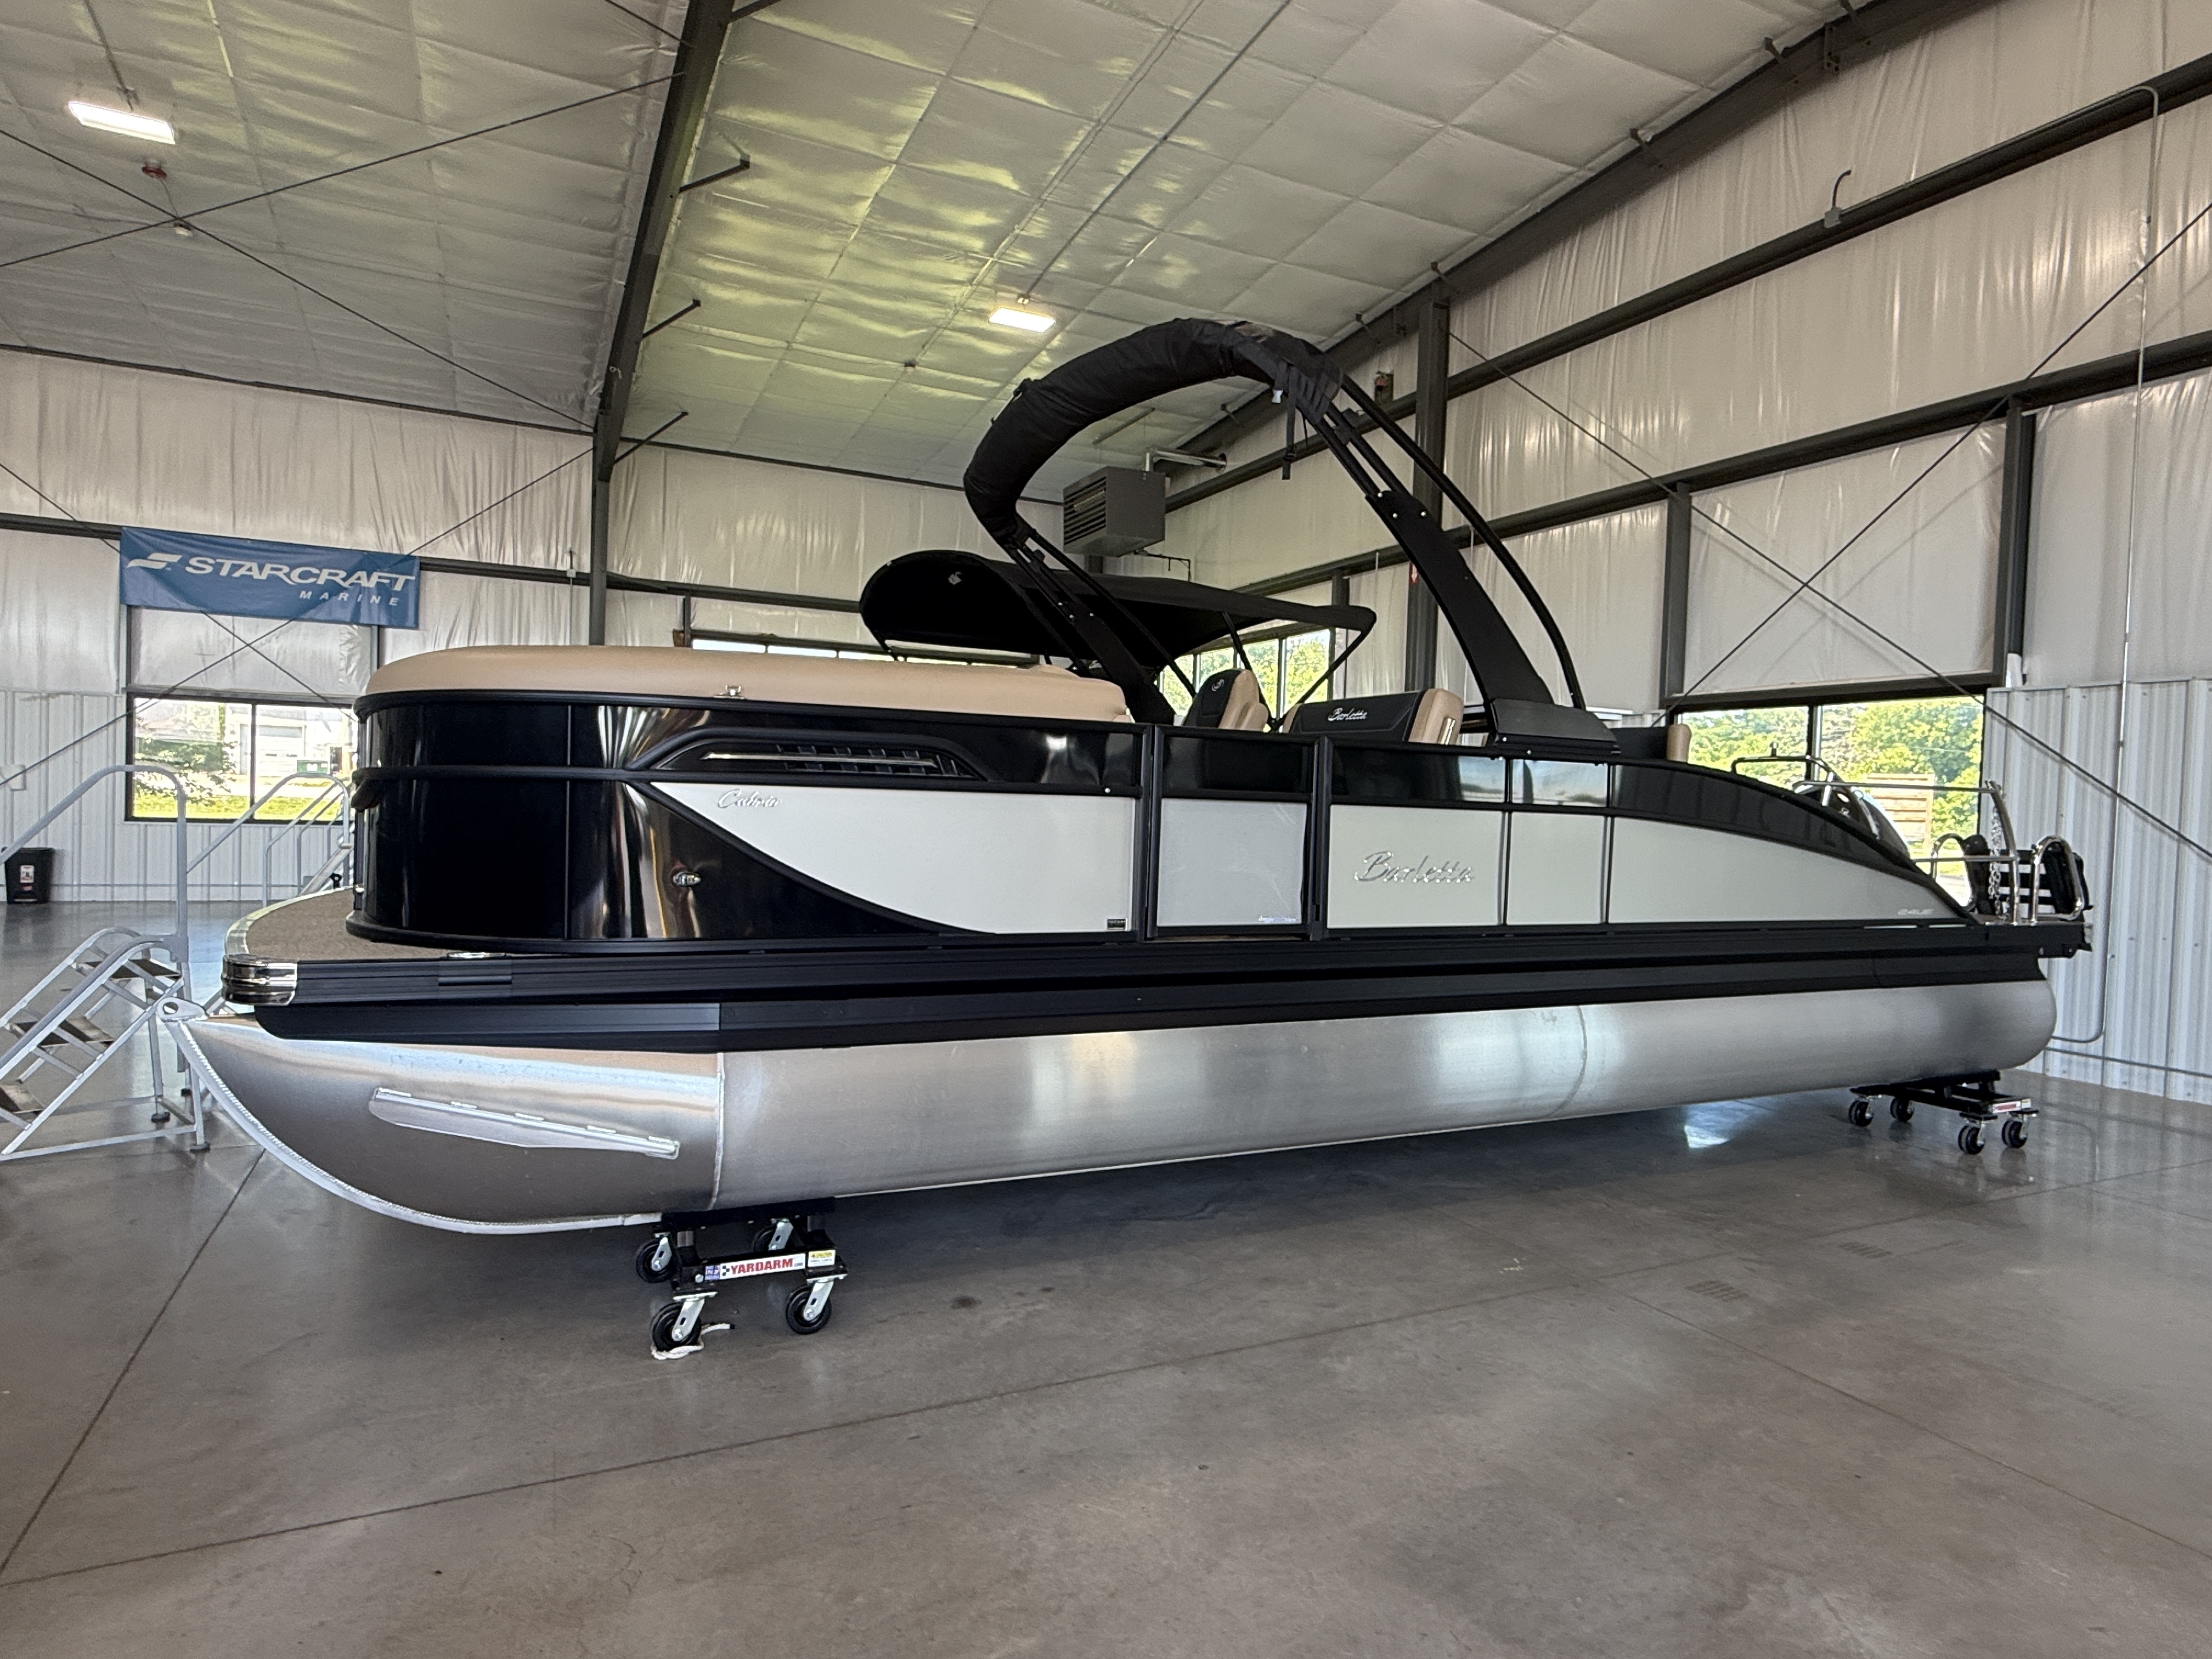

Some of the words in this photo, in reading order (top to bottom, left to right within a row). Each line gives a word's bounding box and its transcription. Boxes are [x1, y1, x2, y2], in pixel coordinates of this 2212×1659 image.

[185, 556, 416, 591] STARCRAFT
[299, 591, 399, 606] MARINE
[1354, 850, 1475, 883] Barletta
[731, 1257, 793, 1275] YARDARM
